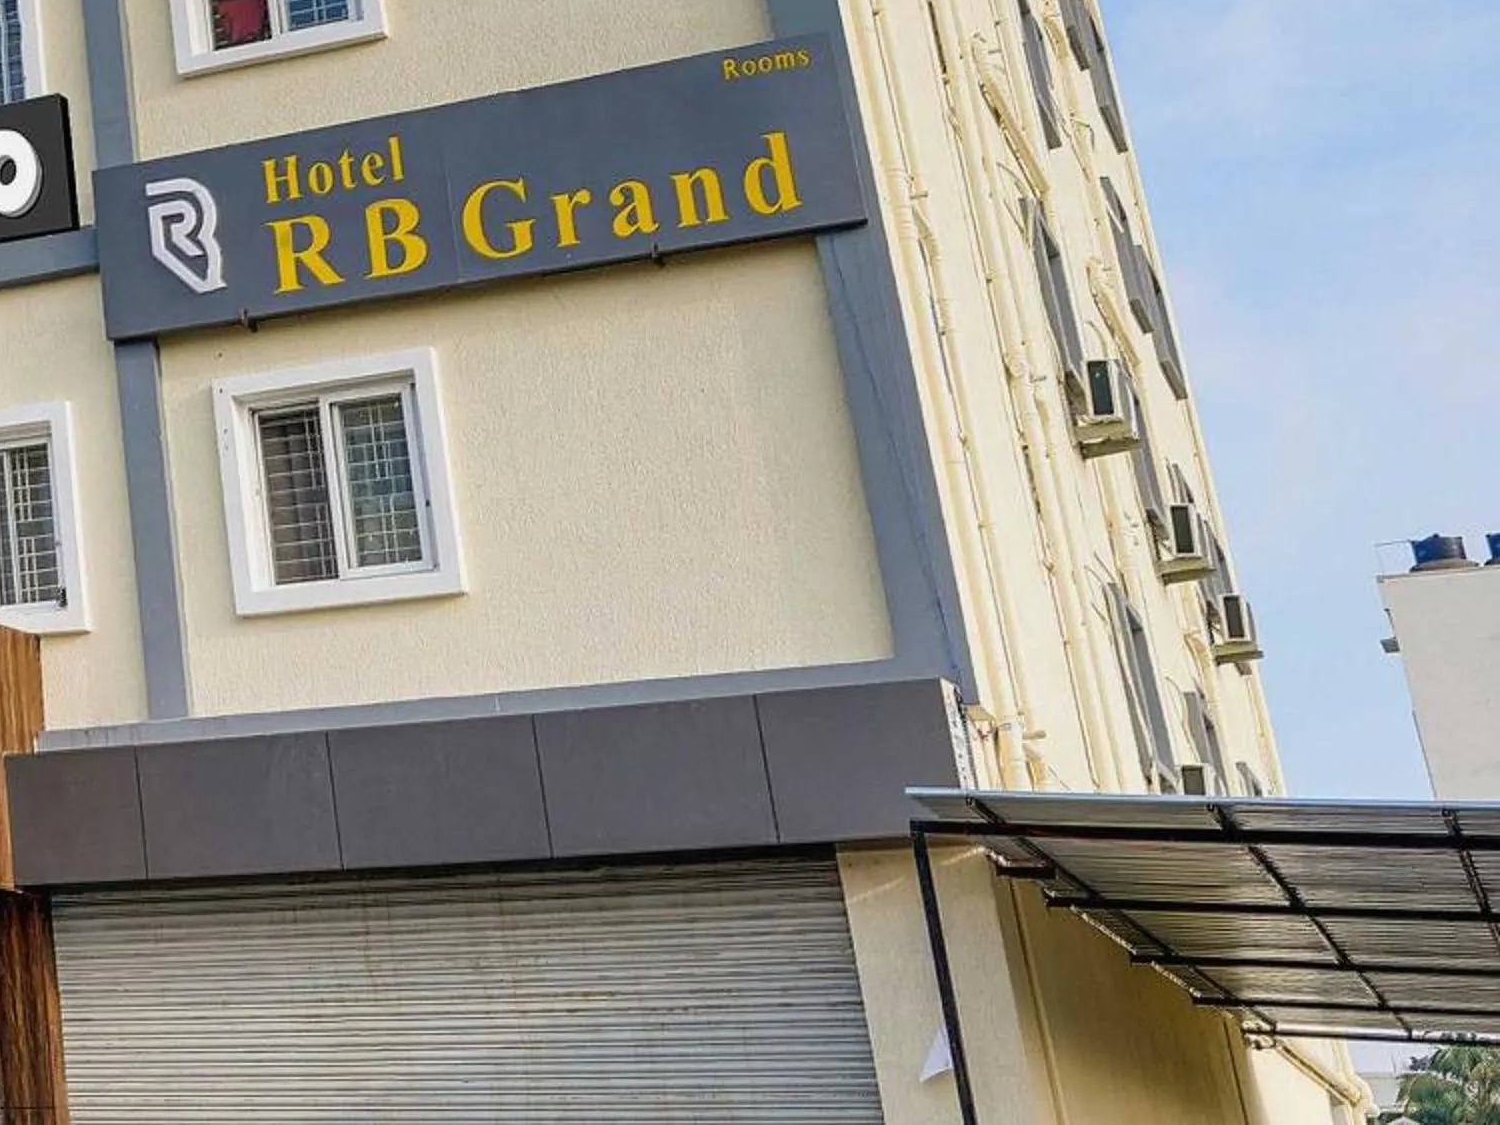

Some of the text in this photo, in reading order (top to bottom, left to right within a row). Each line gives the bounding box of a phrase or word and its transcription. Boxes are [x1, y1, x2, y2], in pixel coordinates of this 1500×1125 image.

[723, 48, 811, 80] Rooms
[262, 135, 406, 204] Hotel
[461, 131, 804, 260] Grand
